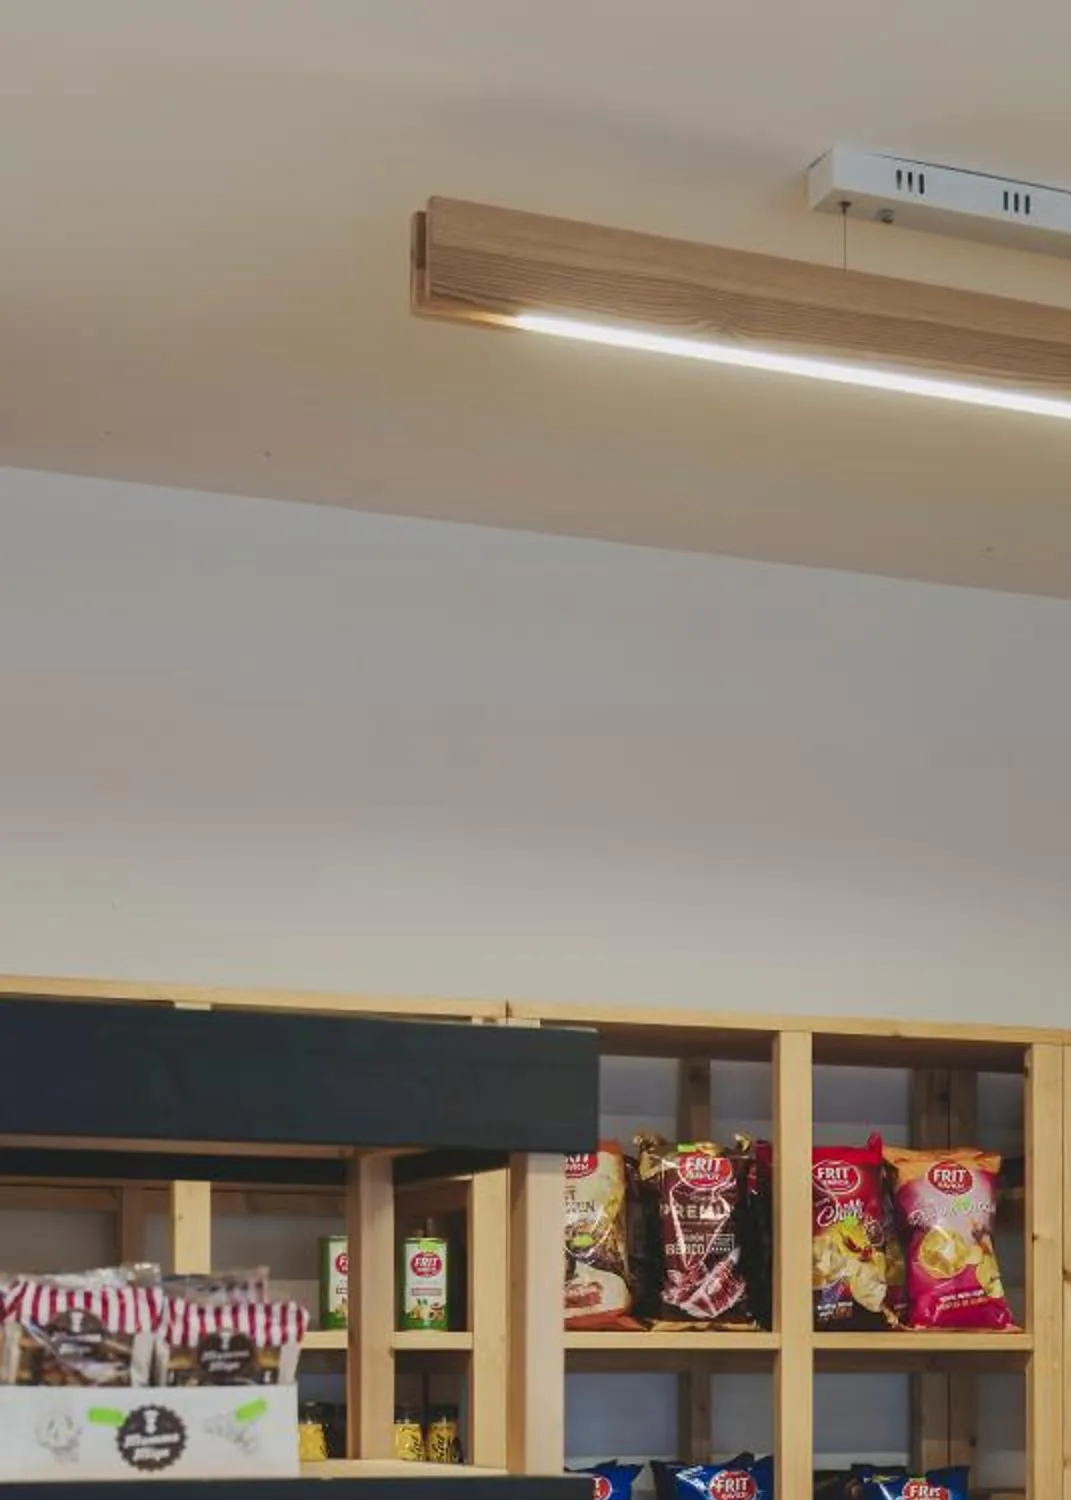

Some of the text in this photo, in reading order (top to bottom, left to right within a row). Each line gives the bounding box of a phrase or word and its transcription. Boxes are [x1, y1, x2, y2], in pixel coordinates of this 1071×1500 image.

[685, 1157, 722, 1174] FRIT
[817, 1168, 850, 1180] FRIT
[932, 1169, 967, 1183] FRIT
[414, 1257, 438, 1269] FRIT
[716, 1477, 749, 1493] FRIT
